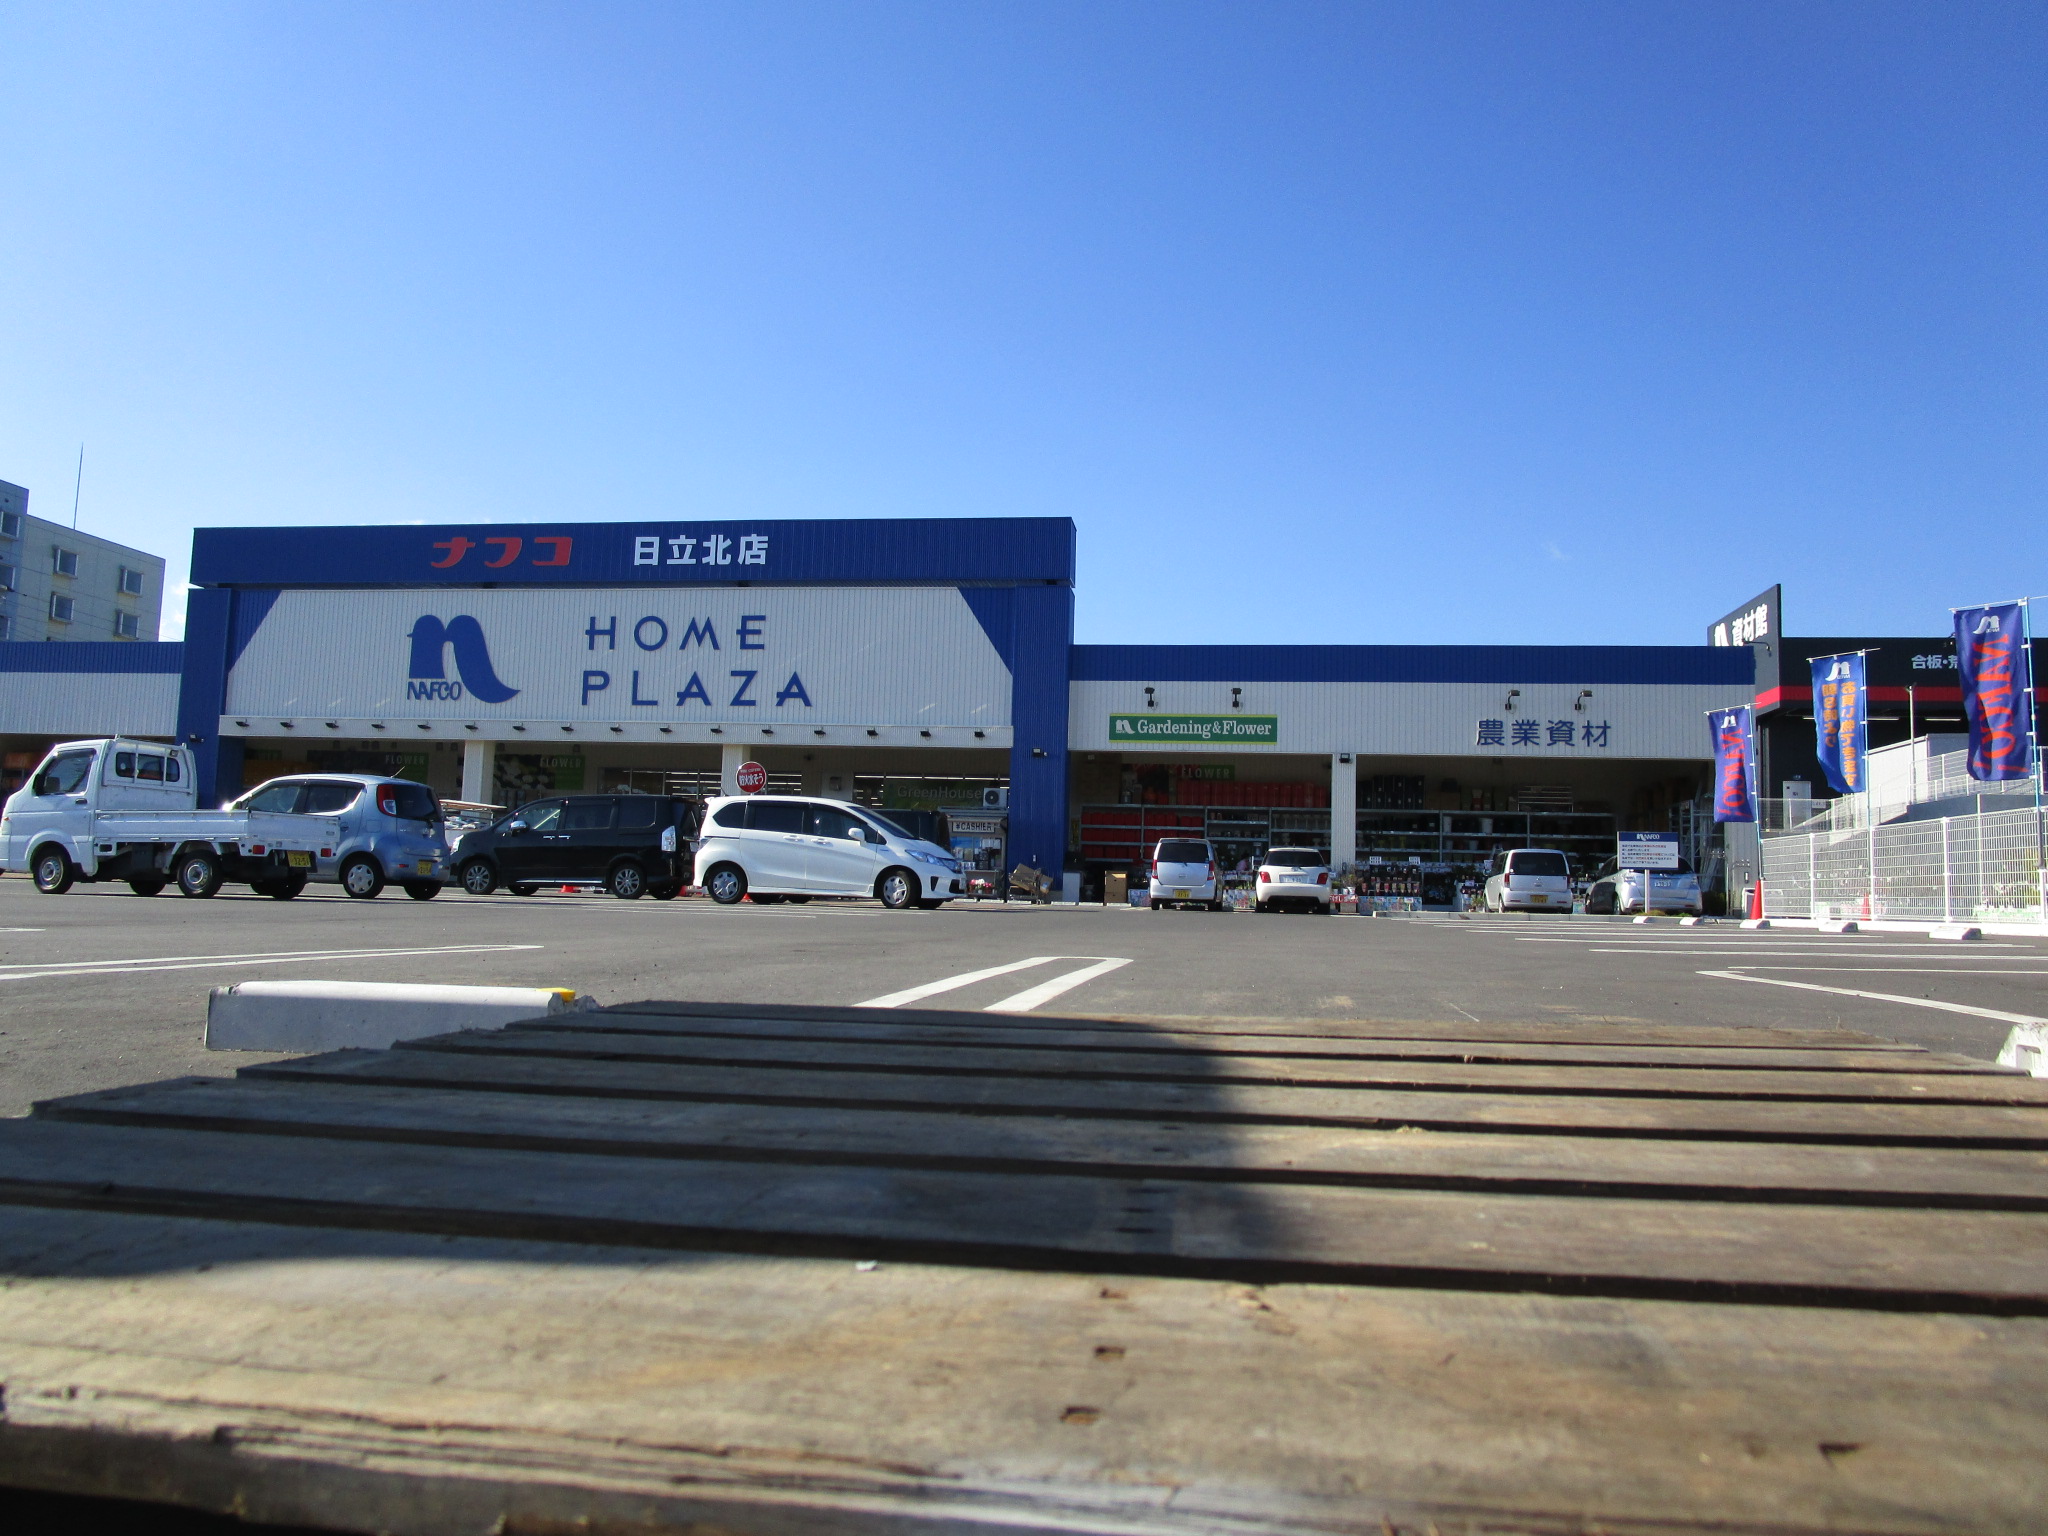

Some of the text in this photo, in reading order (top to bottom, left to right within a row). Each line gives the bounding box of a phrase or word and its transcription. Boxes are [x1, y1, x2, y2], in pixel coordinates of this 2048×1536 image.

[430, 533, 769, 569] ナフコ 日立北店
[584, 615, 766, 651] HOME
[1731, 603, 1768, 646] 資材館
[406, 681, 462, 701] NAFCO
[581, 670, 813, 707] PLAZA
[1476, 718, 1612, 747] 農業資材
[385, 754, 425, 766] FLOWER
[540, 757, 582, 769] FLOWER
[1181, 767, 1230, 779] FLOWER
[897, 785, 982, 800] GreenHouse
